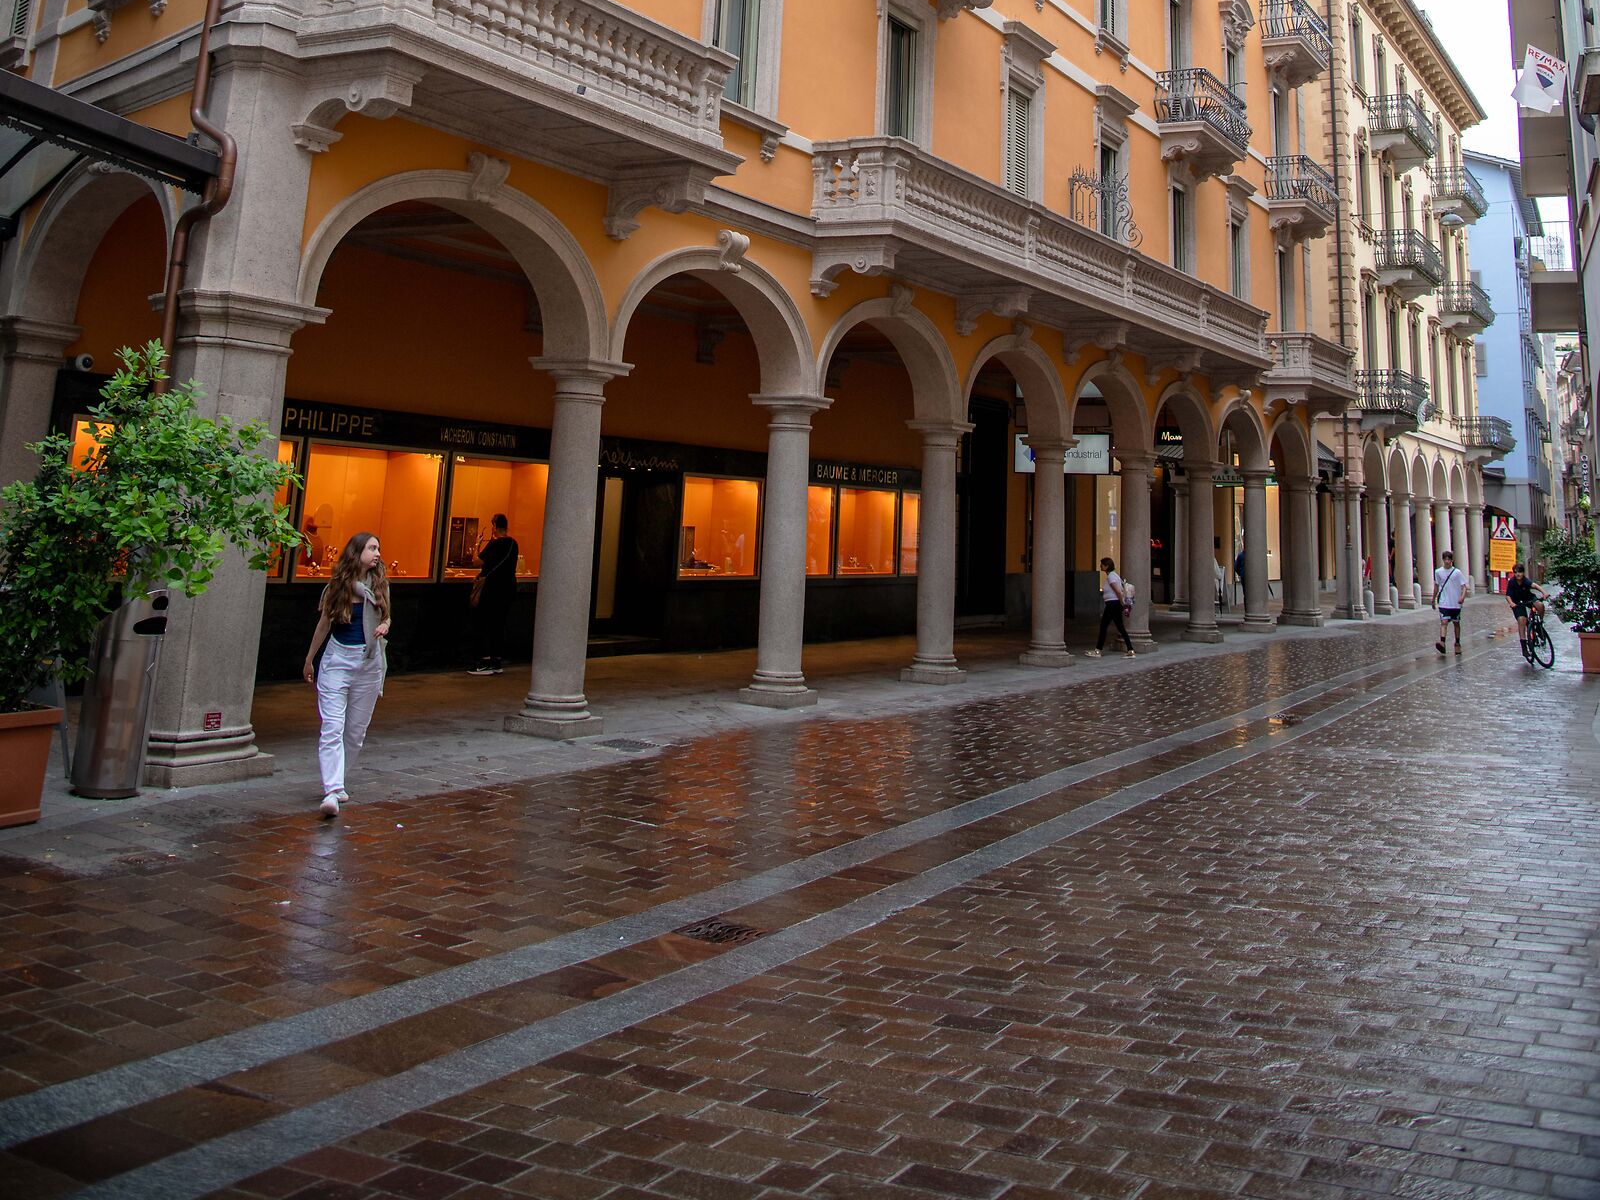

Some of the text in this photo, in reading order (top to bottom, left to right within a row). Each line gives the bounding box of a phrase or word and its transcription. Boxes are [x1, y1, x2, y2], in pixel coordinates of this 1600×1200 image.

[1528, 48, 1566, 73] RE/MAX
[284, 407, 374, 436] PHILIPPE
[440, 426, 517, 449] VACHERON CONSTANTIN
[817, 464, 898, 484] BAUME & MERCIER
